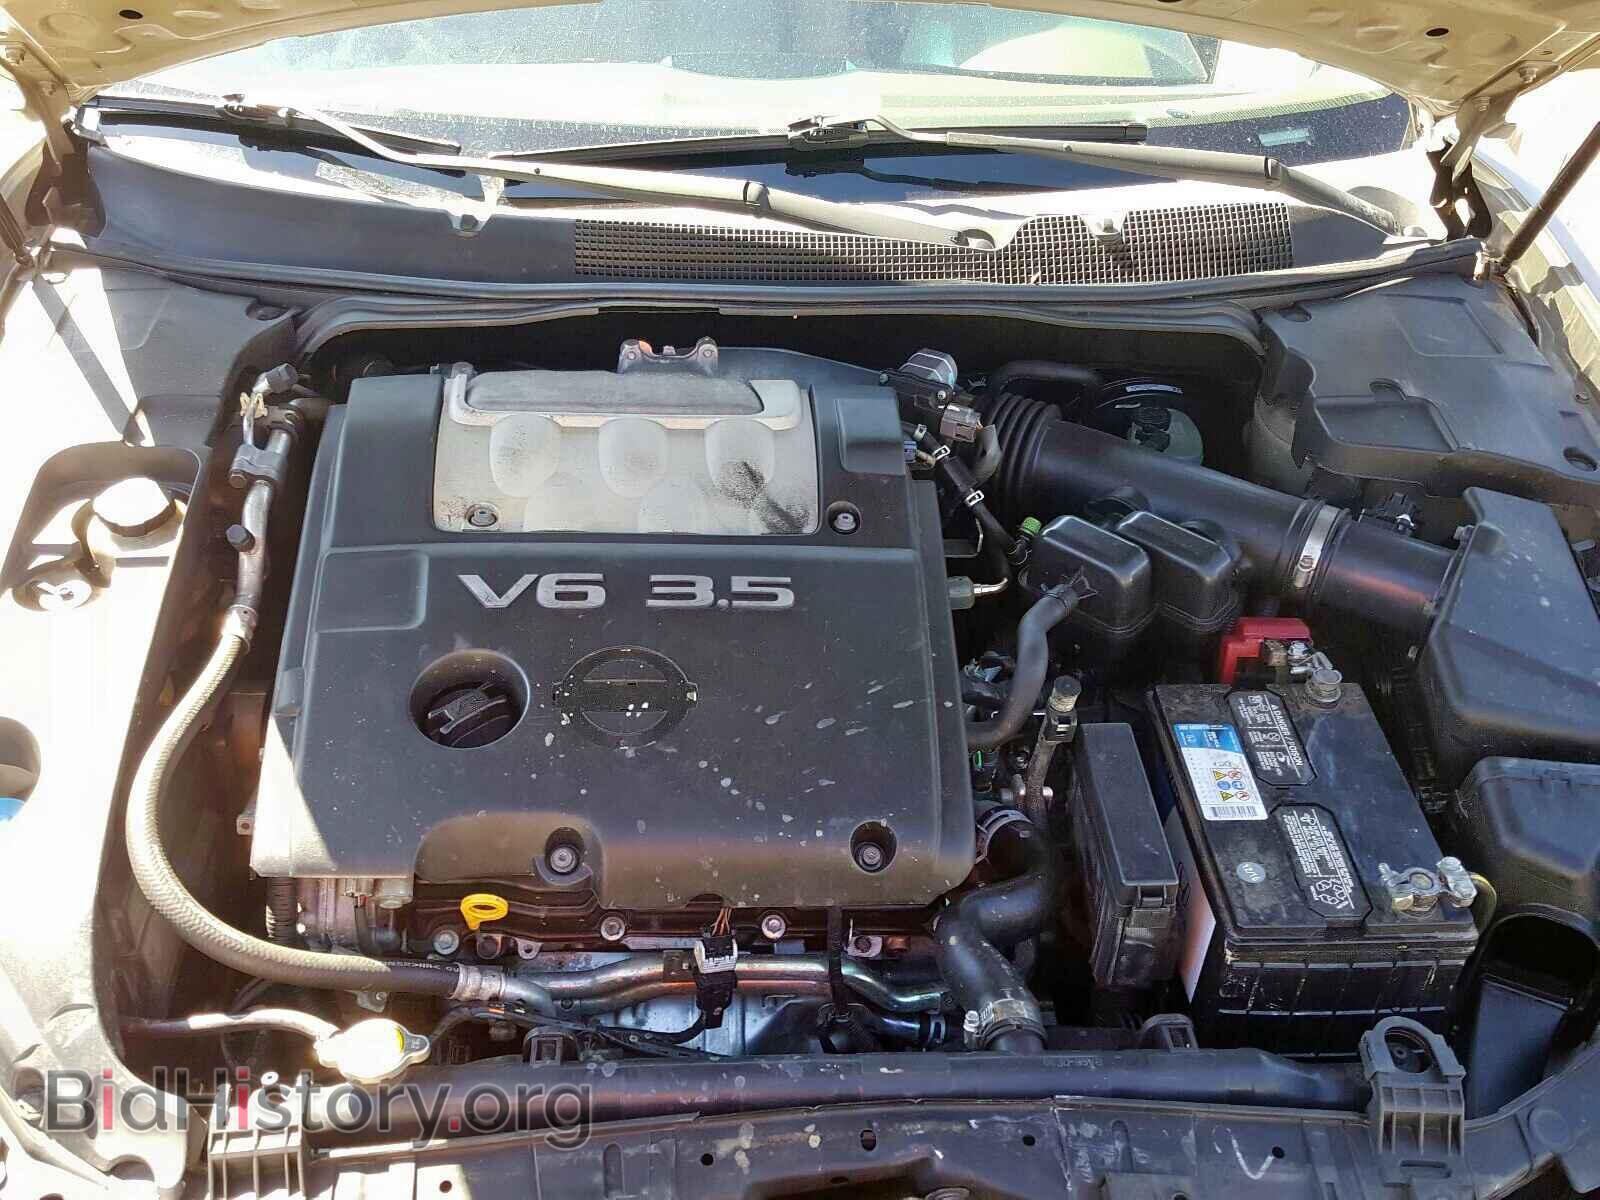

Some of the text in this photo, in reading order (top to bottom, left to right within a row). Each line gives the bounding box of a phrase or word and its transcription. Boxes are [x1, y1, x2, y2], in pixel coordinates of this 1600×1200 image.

[457, 573, 795, 608] V6 3.5
[1273, 710, 1291, 736] DANGER
[1288, 741, 1304, 767] POISON
